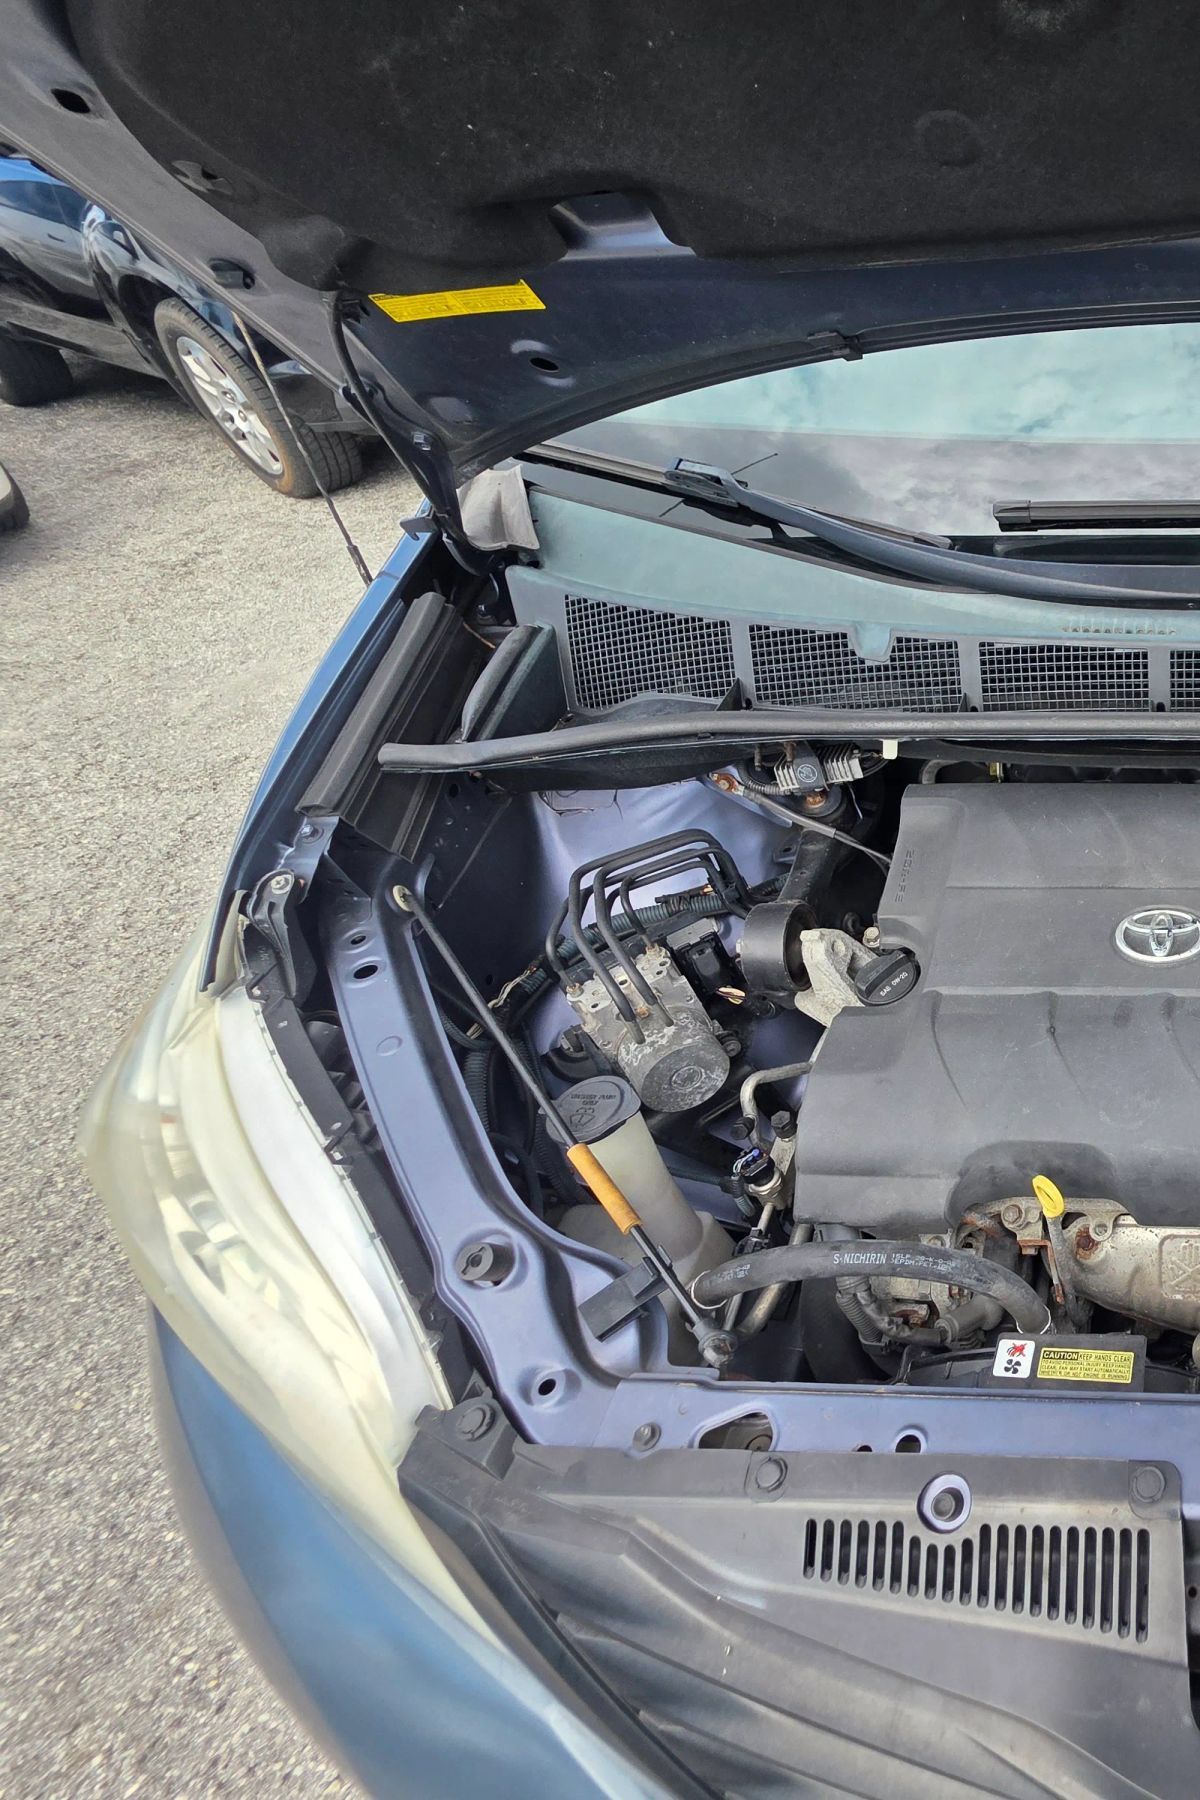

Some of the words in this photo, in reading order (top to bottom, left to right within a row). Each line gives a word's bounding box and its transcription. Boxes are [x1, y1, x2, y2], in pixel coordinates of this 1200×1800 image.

[1043, 1351, 1078, 1360] CAUTION
[1094, 1354, 1112, 1362] HANDS
[1113, 1354, 1130, 1362] CLEAR
